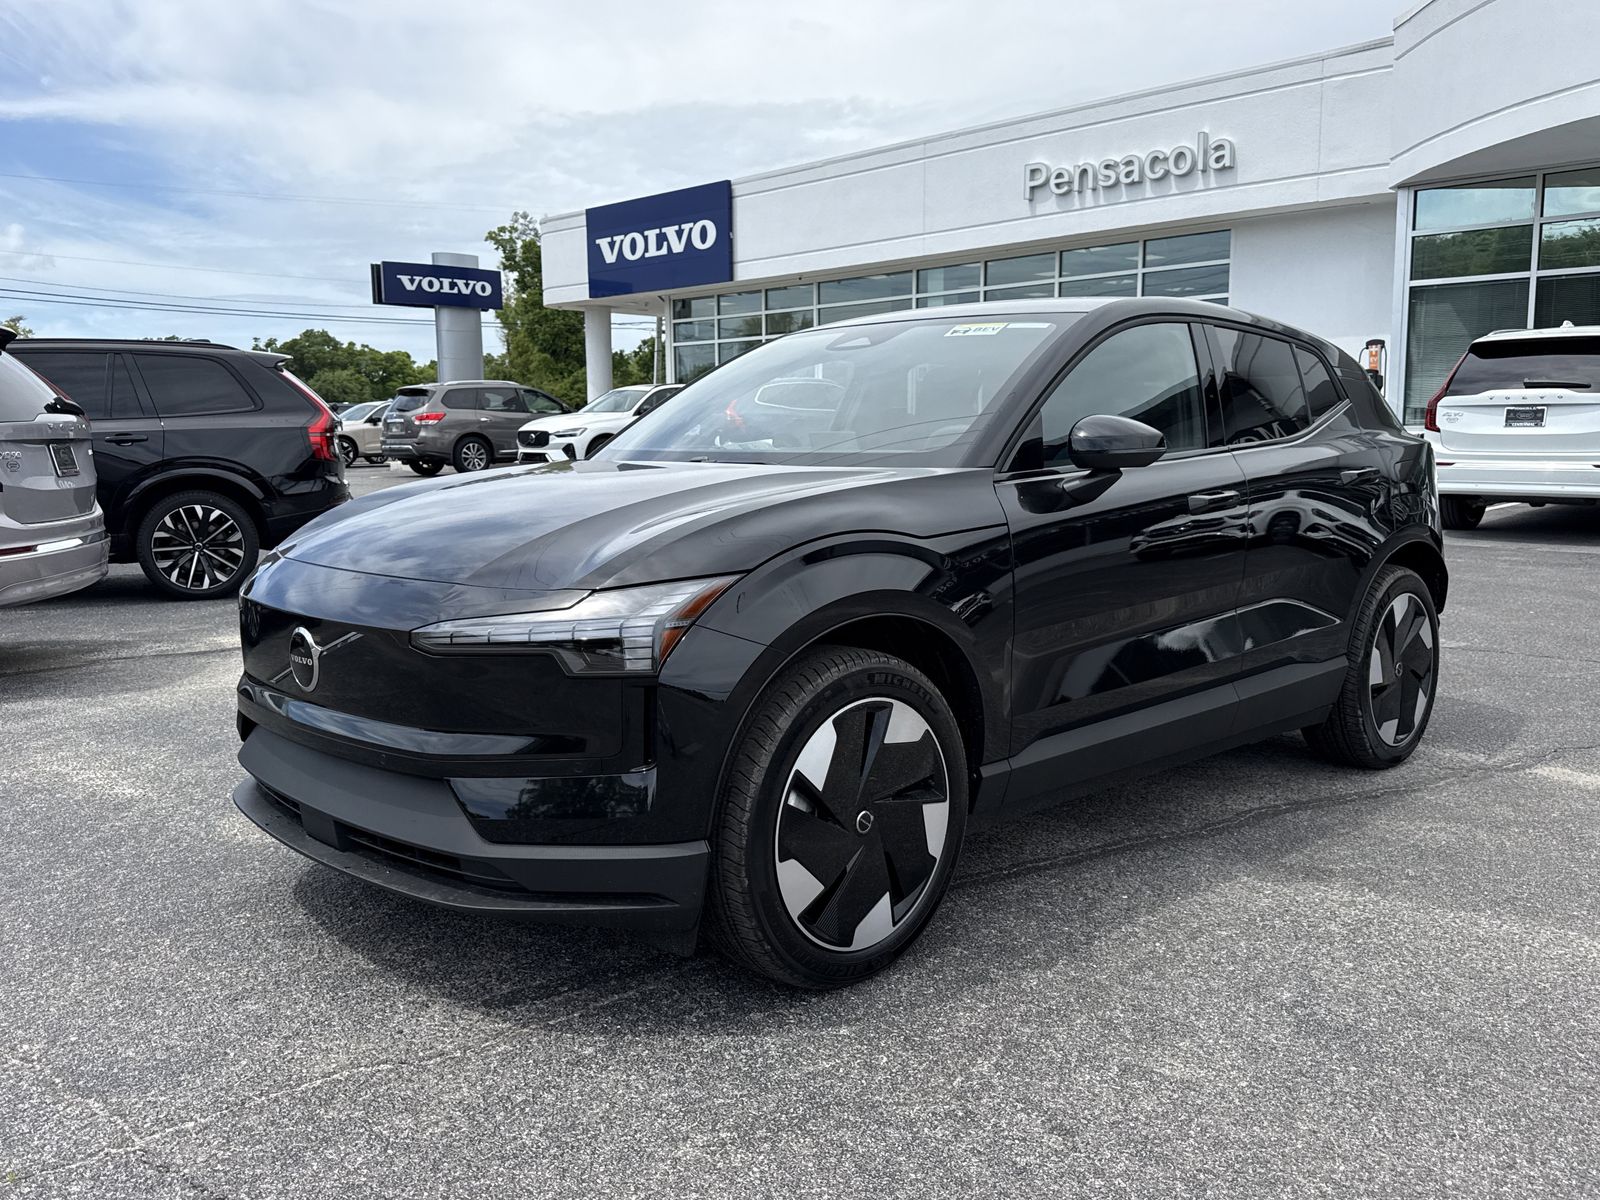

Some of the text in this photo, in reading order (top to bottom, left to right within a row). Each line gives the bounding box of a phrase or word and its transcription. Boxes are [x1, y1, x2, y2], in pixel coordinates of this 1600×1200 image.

[1023, 131, 1235, 201] Pensacola
[595, 219, 717, 264] VOLVO
[396, 274, 492, 297] VOLVO
[290, 653, 313, 666] VOLVO
